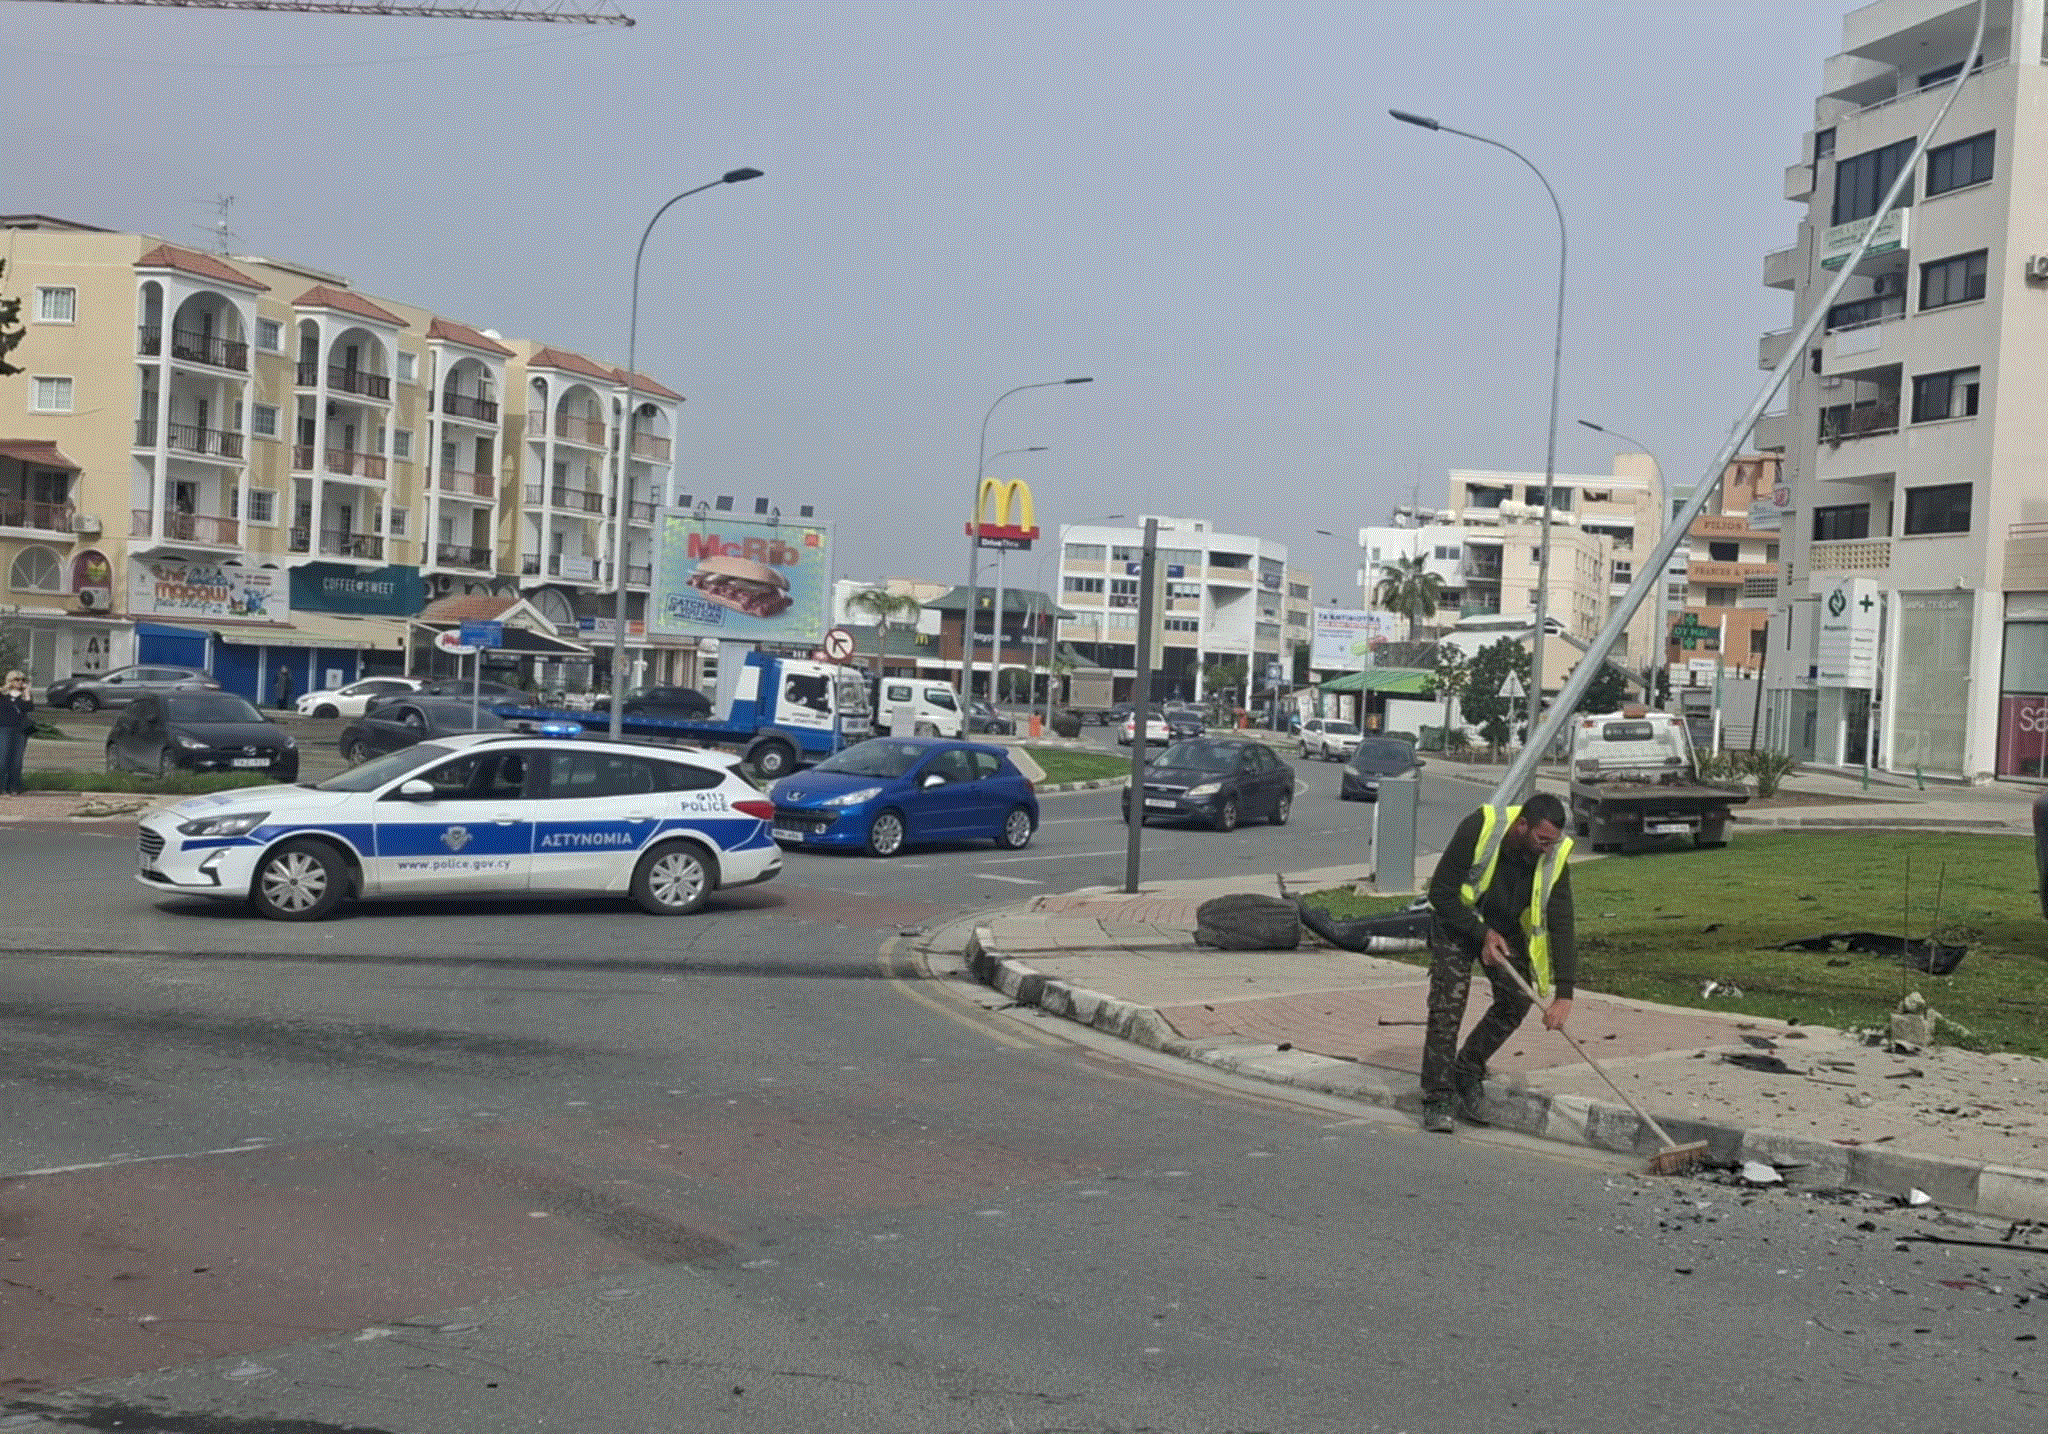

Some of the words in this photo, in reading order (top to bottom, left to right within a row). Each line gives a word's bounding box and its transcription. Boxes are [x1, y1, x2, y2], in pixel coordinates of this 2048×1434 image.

[688, 532, 798, 566] McRib
[323, 577, 356, 592] COFFEE
[364, 579, 395, 594] SWEET
[681, 801, 729, 812] POLICE
[541, 832, 633, 847] ΑΣΤΥΝΟΜΙΑ
[398, 859, 511, 871] www.police.gov.cy
